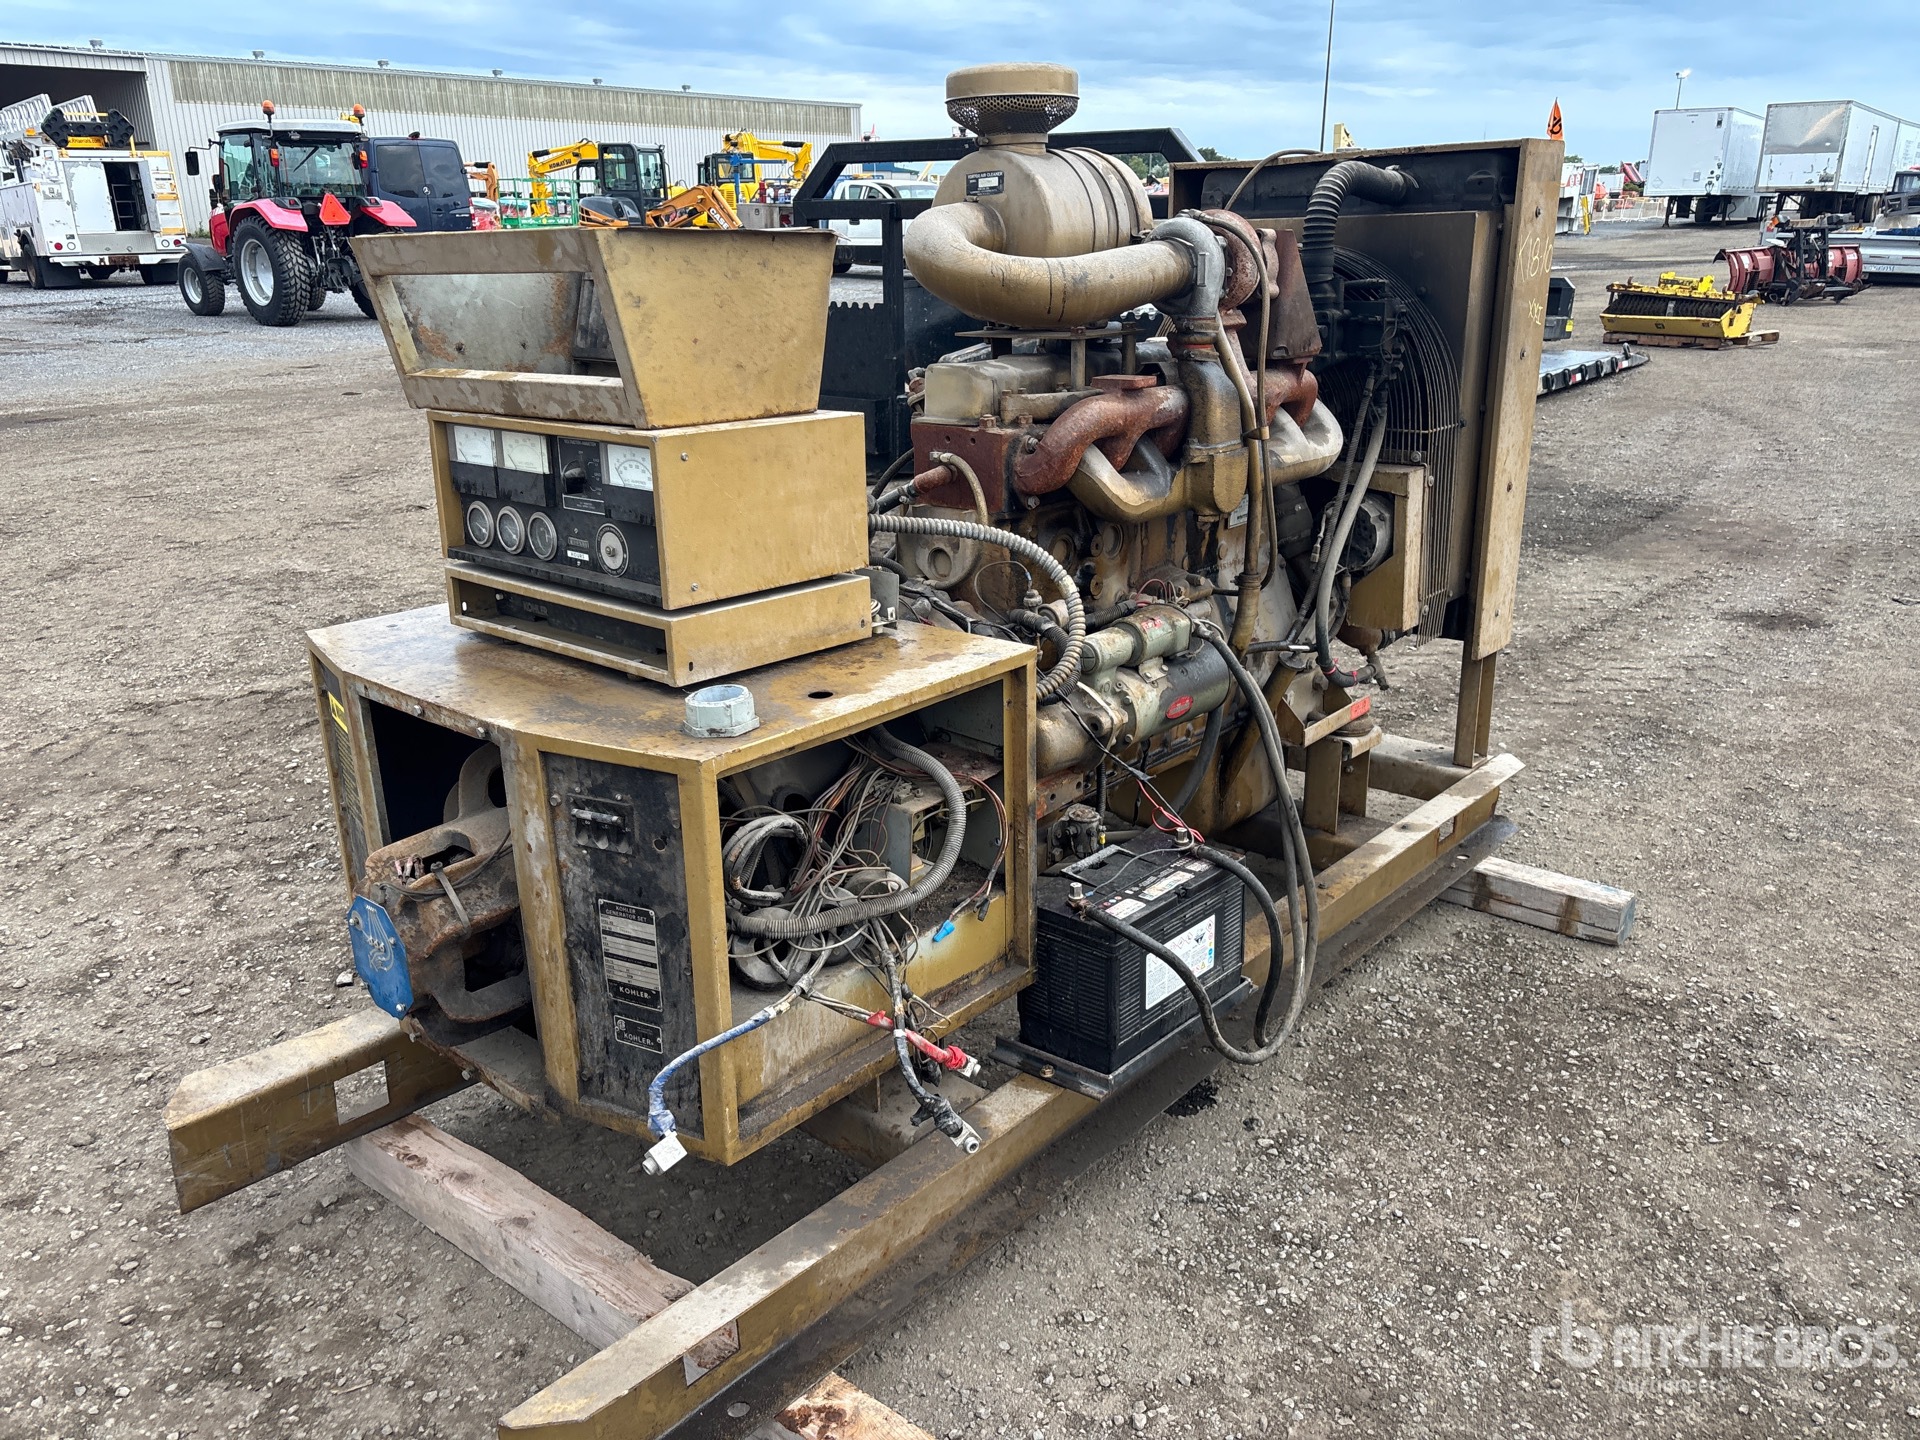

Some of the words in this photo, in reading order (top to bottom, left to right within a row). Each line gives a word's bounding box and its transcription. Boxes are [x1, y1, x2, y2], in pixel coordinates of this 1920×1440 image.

[549, 158, 572, 169] KOMATSU
[709, 207, 730, 229] CASE
[605, 908, 637, 921] GENERATOR
[619, 986, 649, 999] KOHLER
[623, 1032, 651, 1046] KOHLER
